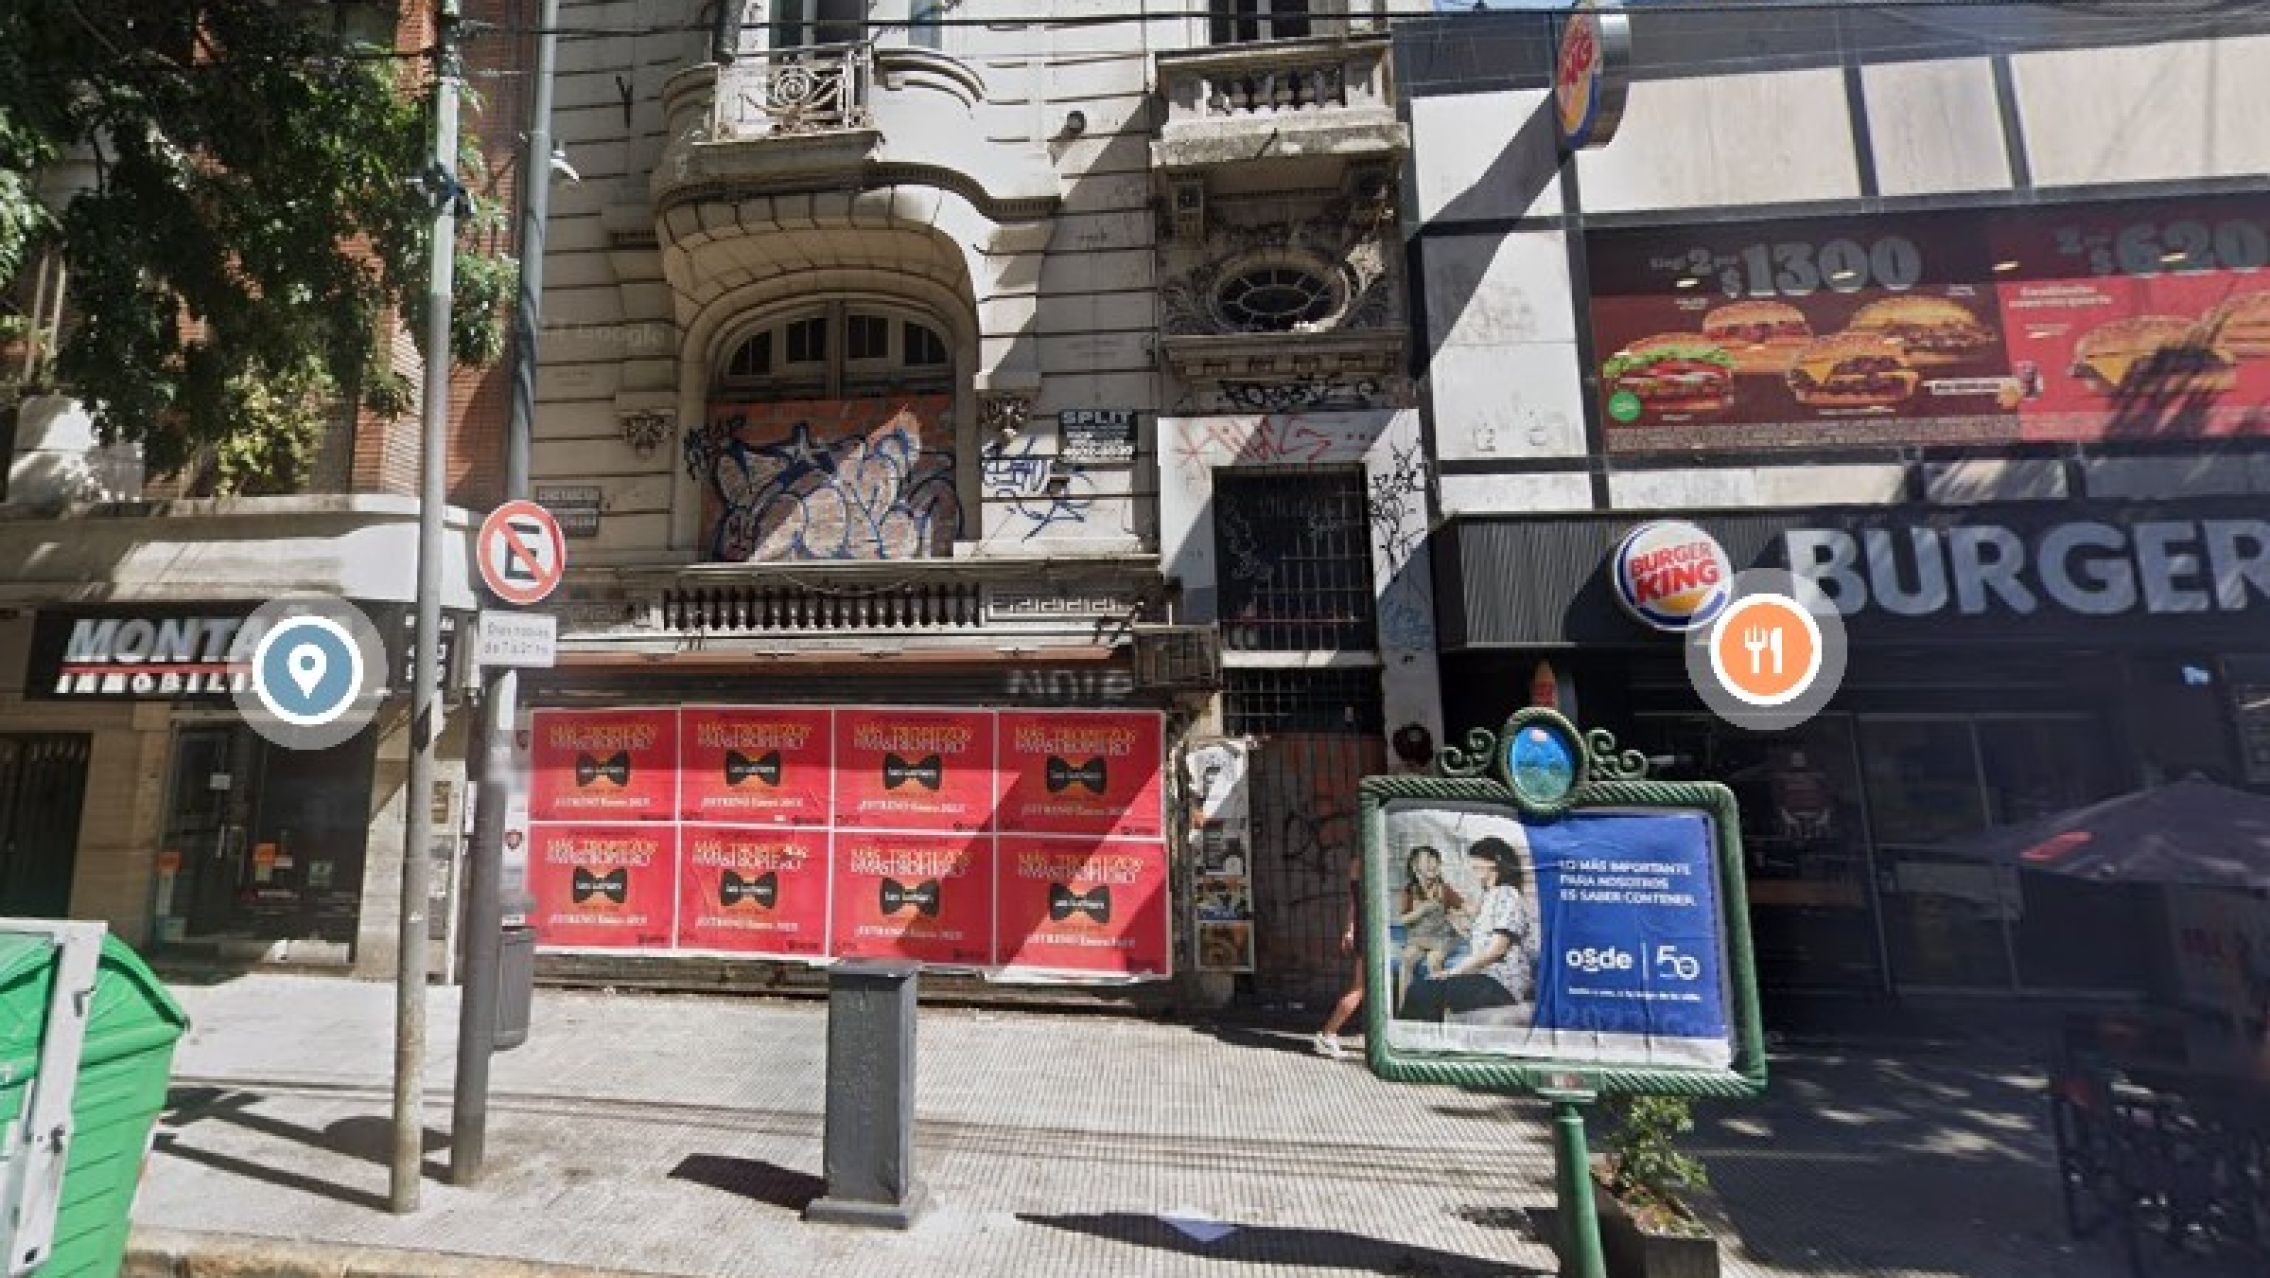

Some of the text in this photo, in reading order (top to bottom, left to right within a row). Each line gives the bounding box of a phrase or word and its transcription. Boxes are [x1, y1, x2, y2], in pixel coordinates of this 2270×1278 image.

[1063, 410, 1133, 424] SPLIT
[1628, 541, 1714, 580] BURGER
[1783, 519, 2270, 617] BURGER
[1634, 558, 1721, 604] KING
[1560, 874, 1595, 886] PARA
[1560, 888, 1577, 900] ES
[1565, 945, 1633, 973] osde
